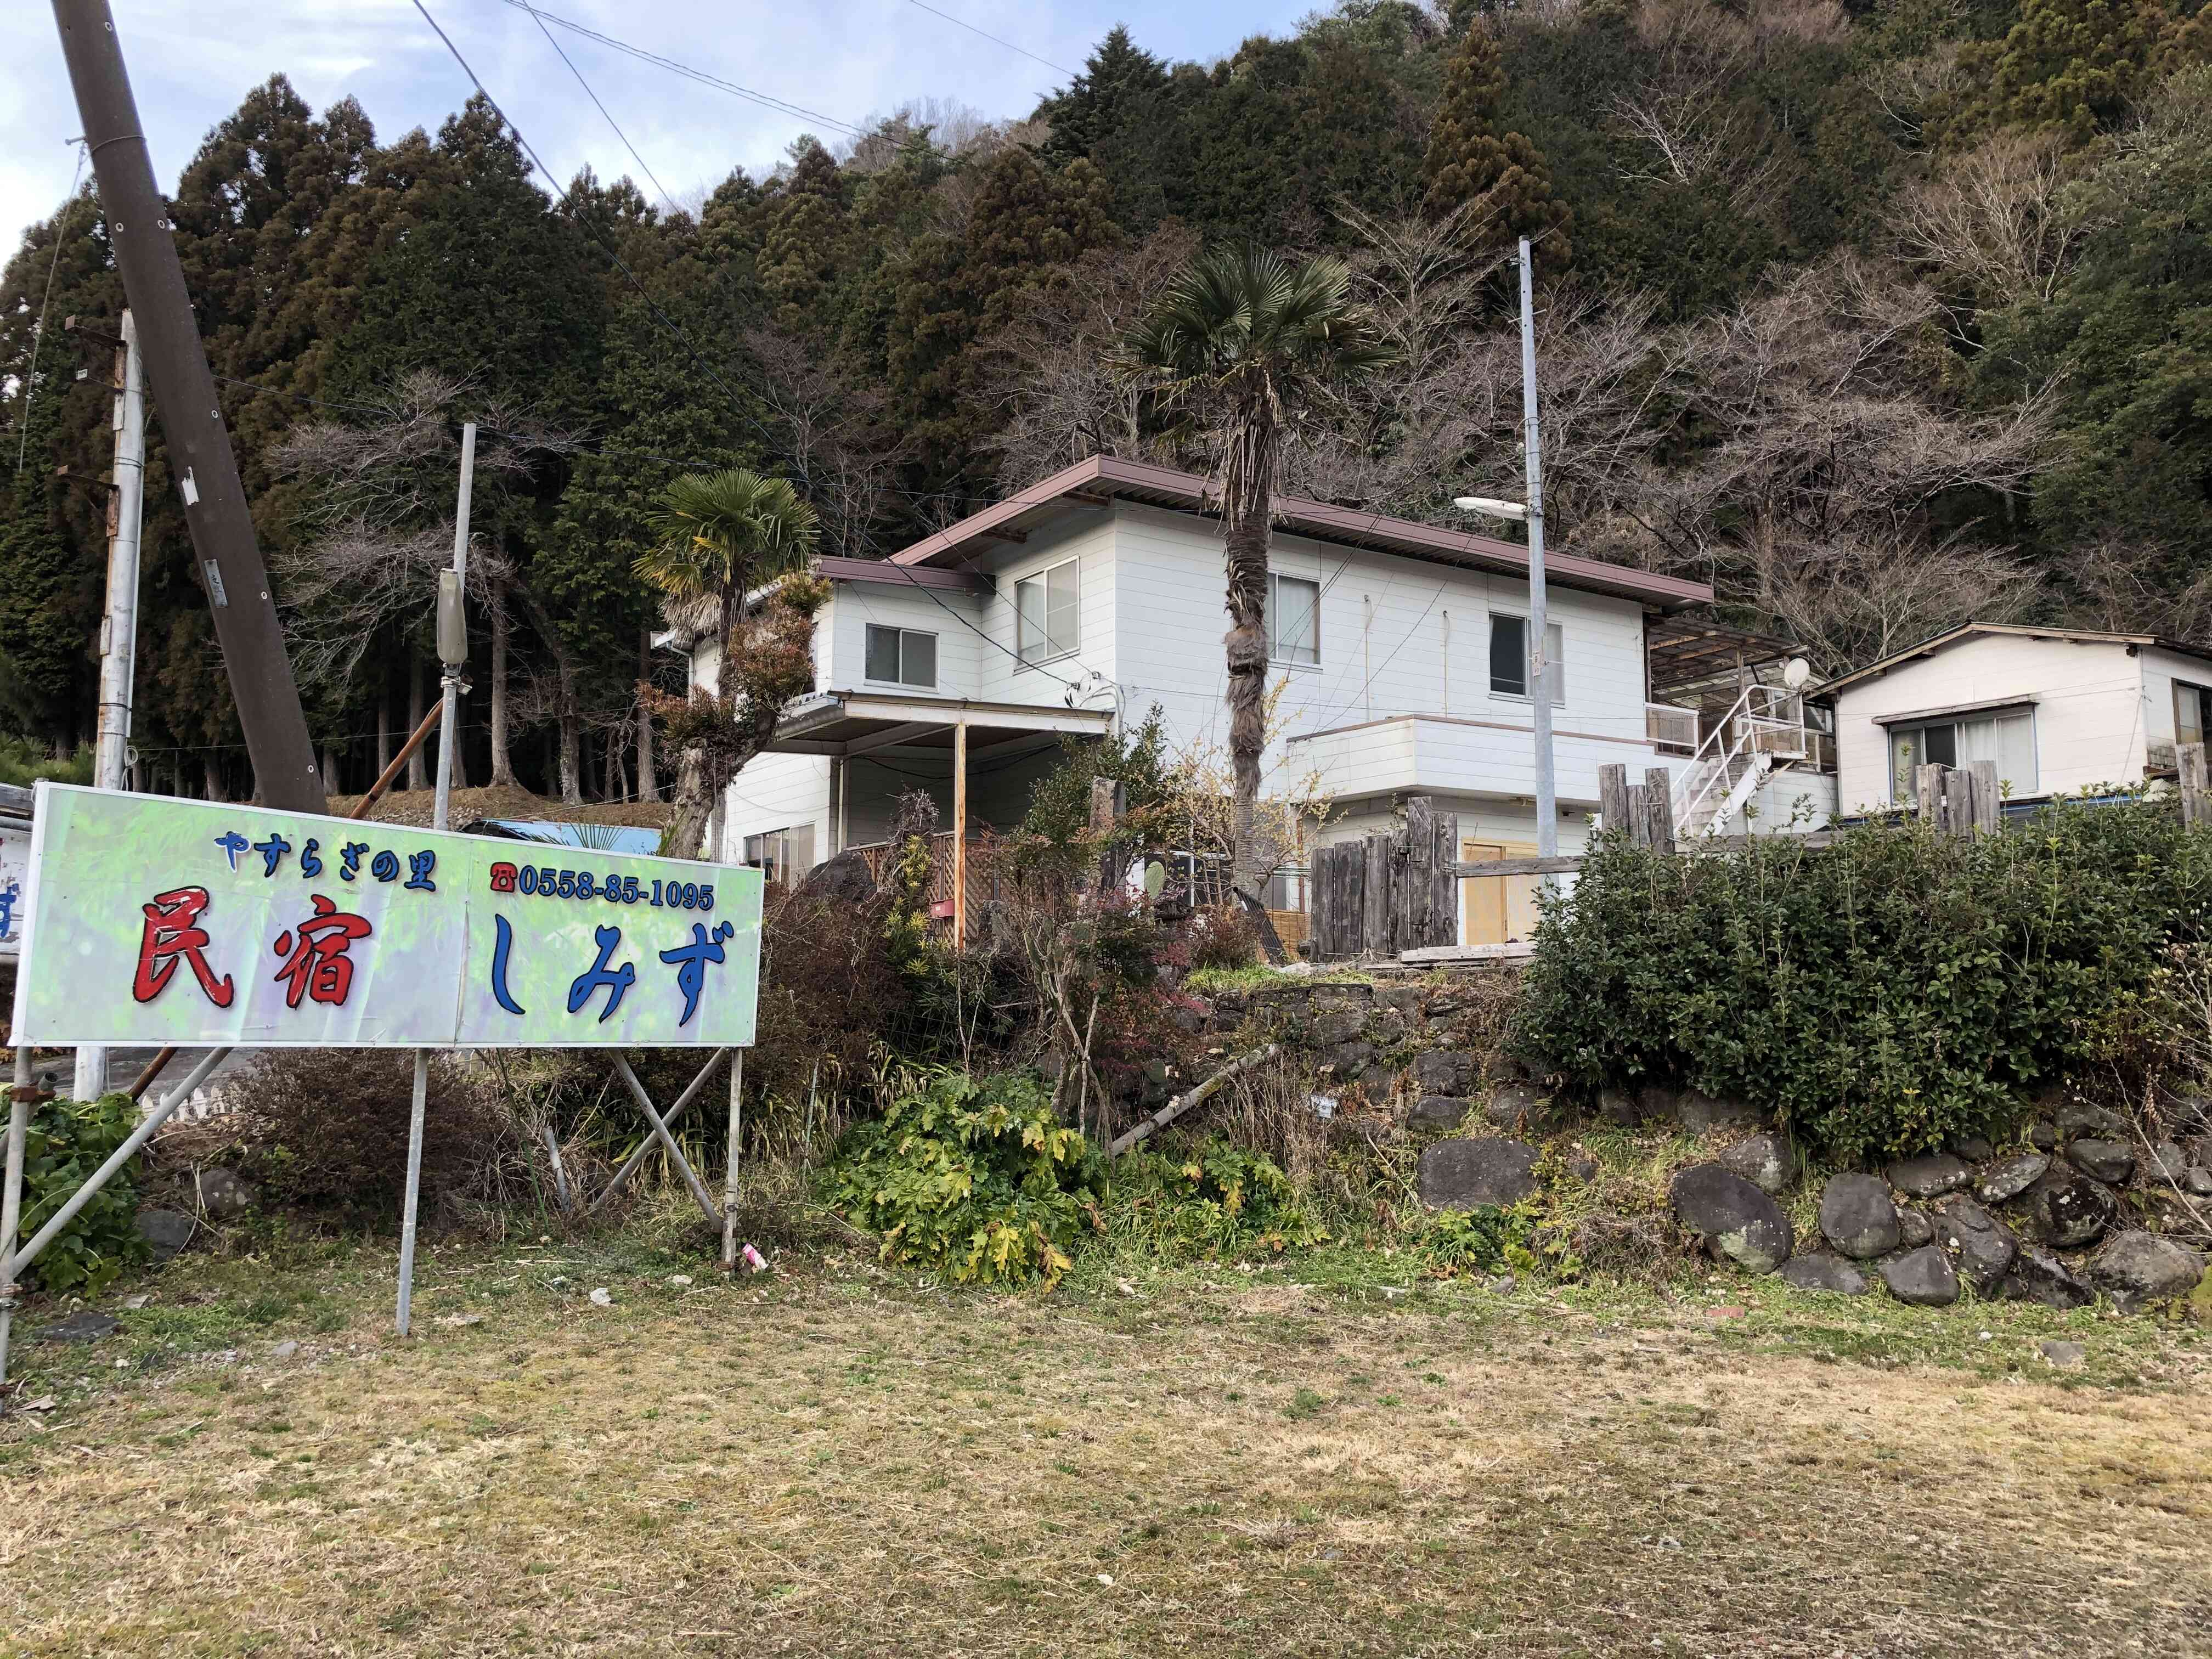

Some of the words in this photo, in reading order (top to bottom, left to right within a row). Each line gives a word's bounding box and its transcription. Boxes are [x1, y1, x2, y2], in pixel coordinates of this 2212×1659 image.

[214, 831, 437, 892] やすらぎの里
[518, 865, 714, 911] 0558-85-1095
[132, 885, 373, 1009] 民宿
[492, 913, 735, 1028] しみず
